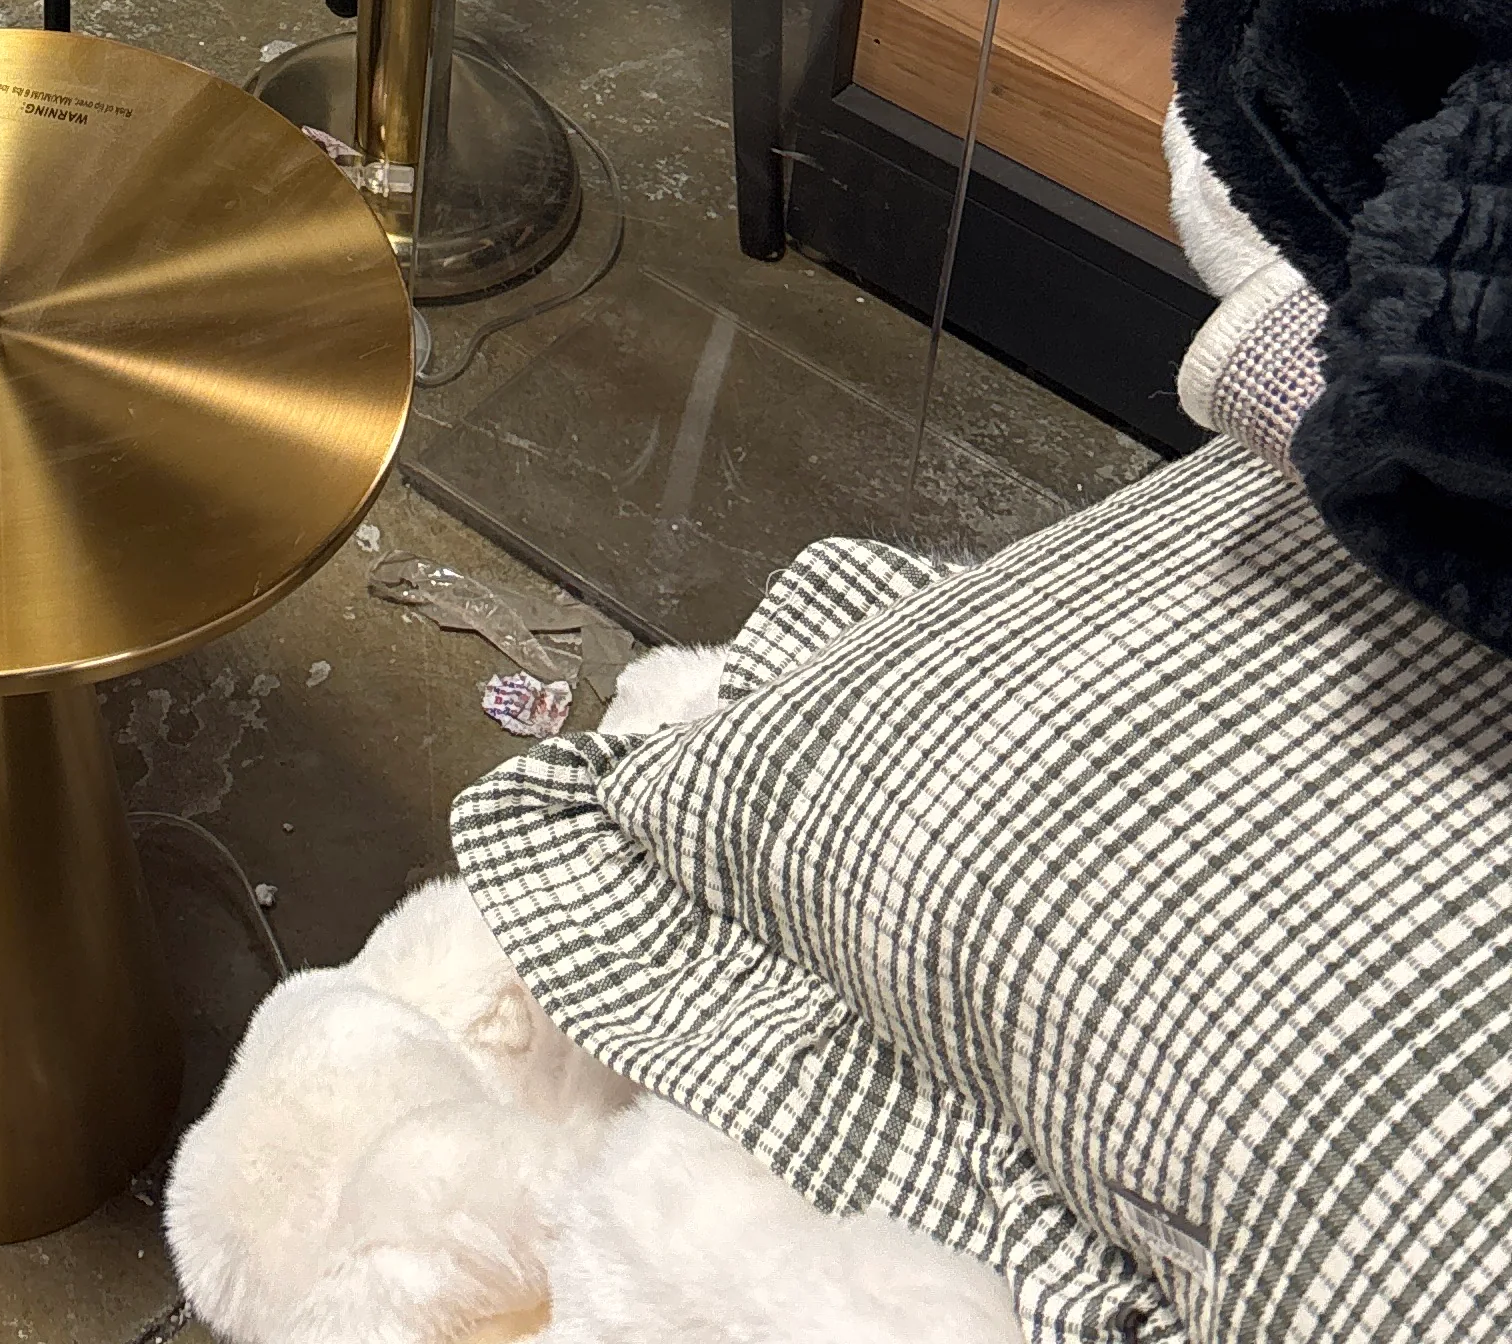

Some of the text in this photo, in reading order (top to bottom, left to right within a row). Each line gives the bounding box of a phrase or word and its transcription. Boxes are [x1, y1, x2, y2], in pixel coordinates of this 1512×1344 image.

[30, 90, 72, 106] MAXIMUM
[21, 101, 88, 125] WARNING:
[115, 106, 133, 118] Risk
